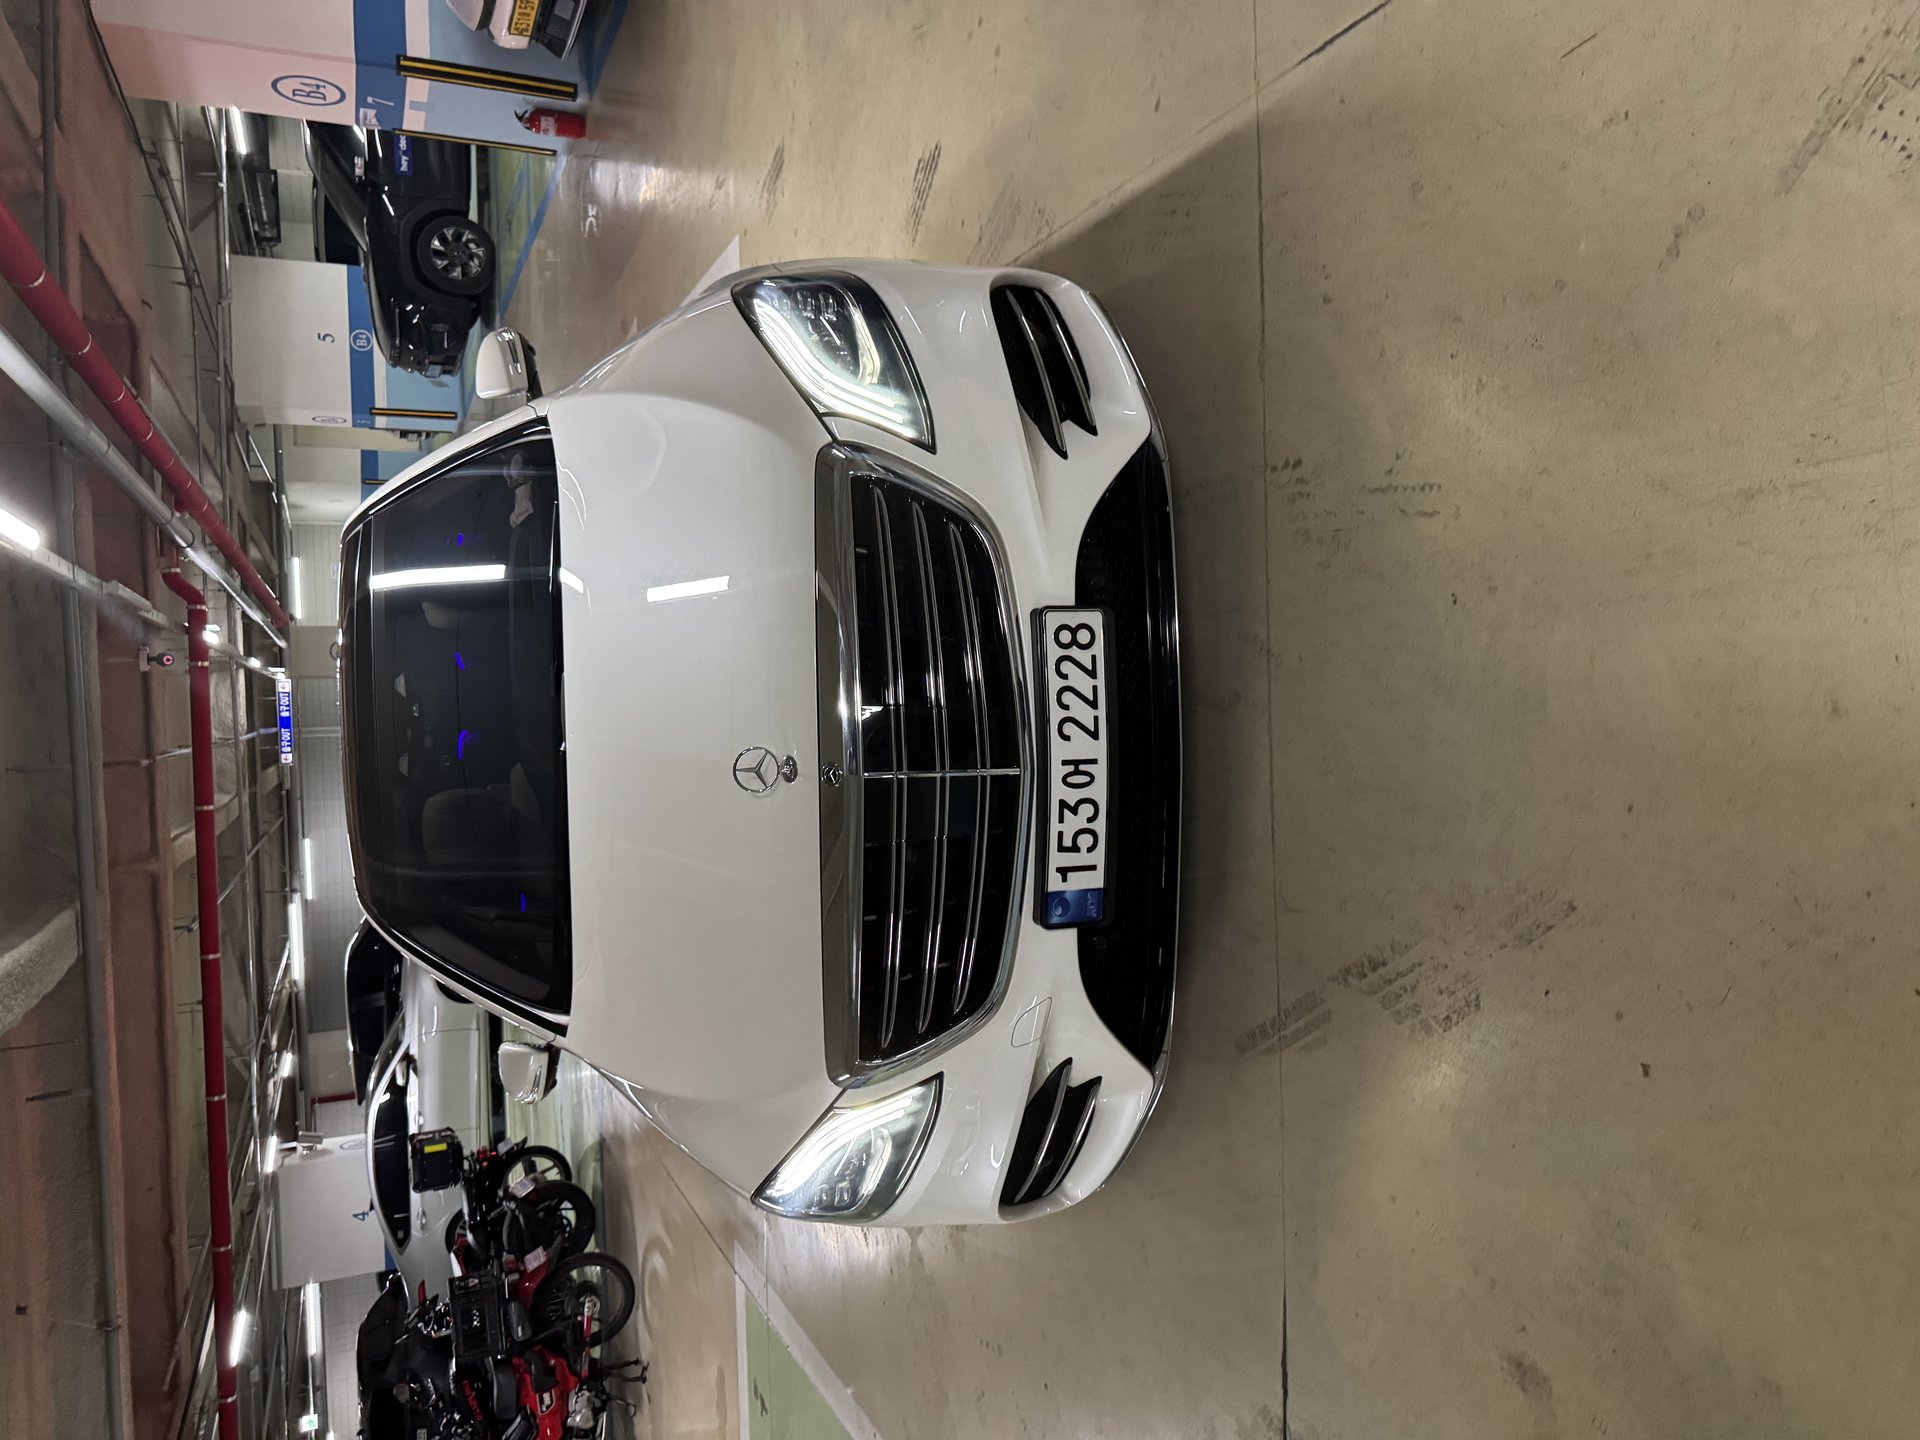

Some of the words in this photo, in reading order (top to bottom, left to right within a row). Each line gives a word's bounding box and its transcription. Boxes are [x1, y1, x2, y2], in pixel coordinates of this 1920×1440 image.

[292, 82, 326, 102] B4
[366, 96, 394, 106] 7
[318, 332, 335, 344] 5
[356, 334, 368, 346] B4
[1053, 622, 1100, 742] 2228
[1056, 758, 1098, 883] 153어
[352, 1211, 369, 1222] 4
